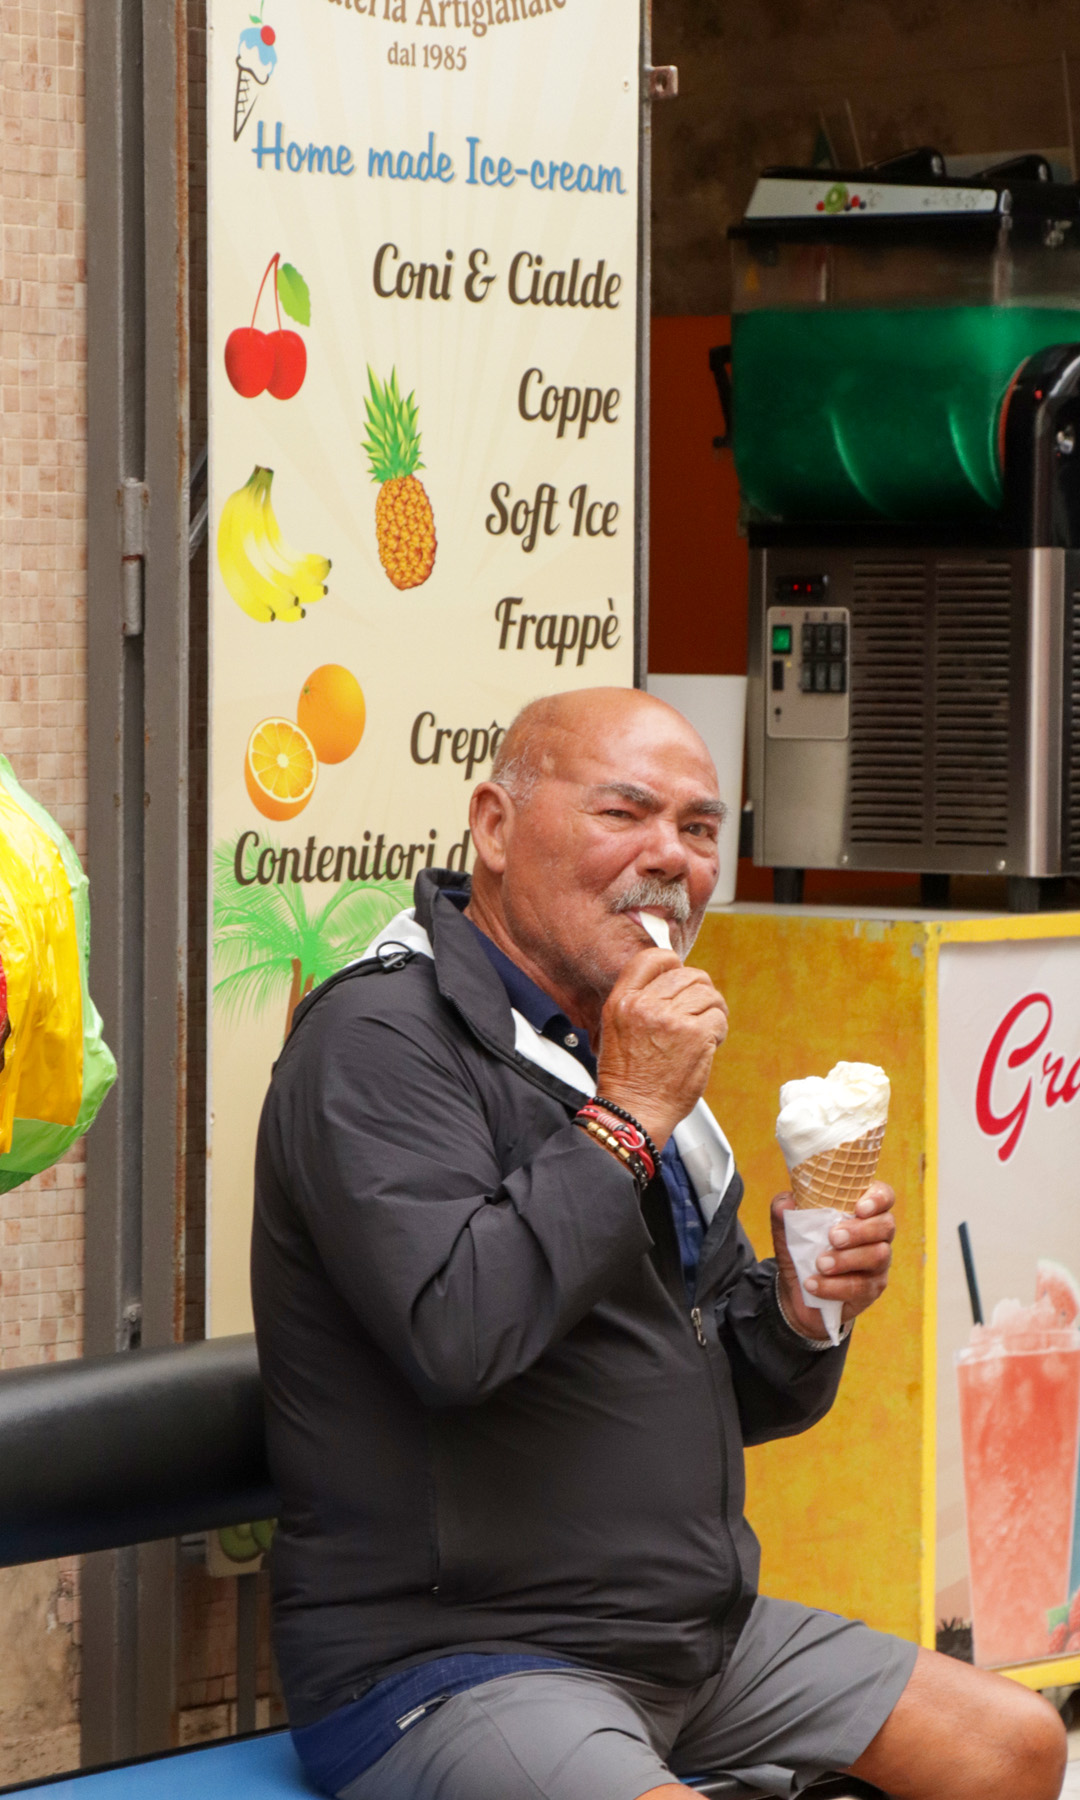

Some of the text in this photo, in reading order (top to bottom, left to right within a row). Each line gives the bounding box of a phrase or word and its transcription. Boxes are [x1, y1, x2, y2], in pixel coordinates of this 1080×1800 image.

[387, 42, 467, 71] dal 1985
[252, 120, 626, 195] Home made Ice-cream
[373, 243, 622, 309] Coni & Cialde
[518, 368, 620, 438] Coppe
[485, 482, 619, 553] Soft Ice
[495, 597, 620, 667] Frappè
[234, 829, 437, 886] Contenitori
